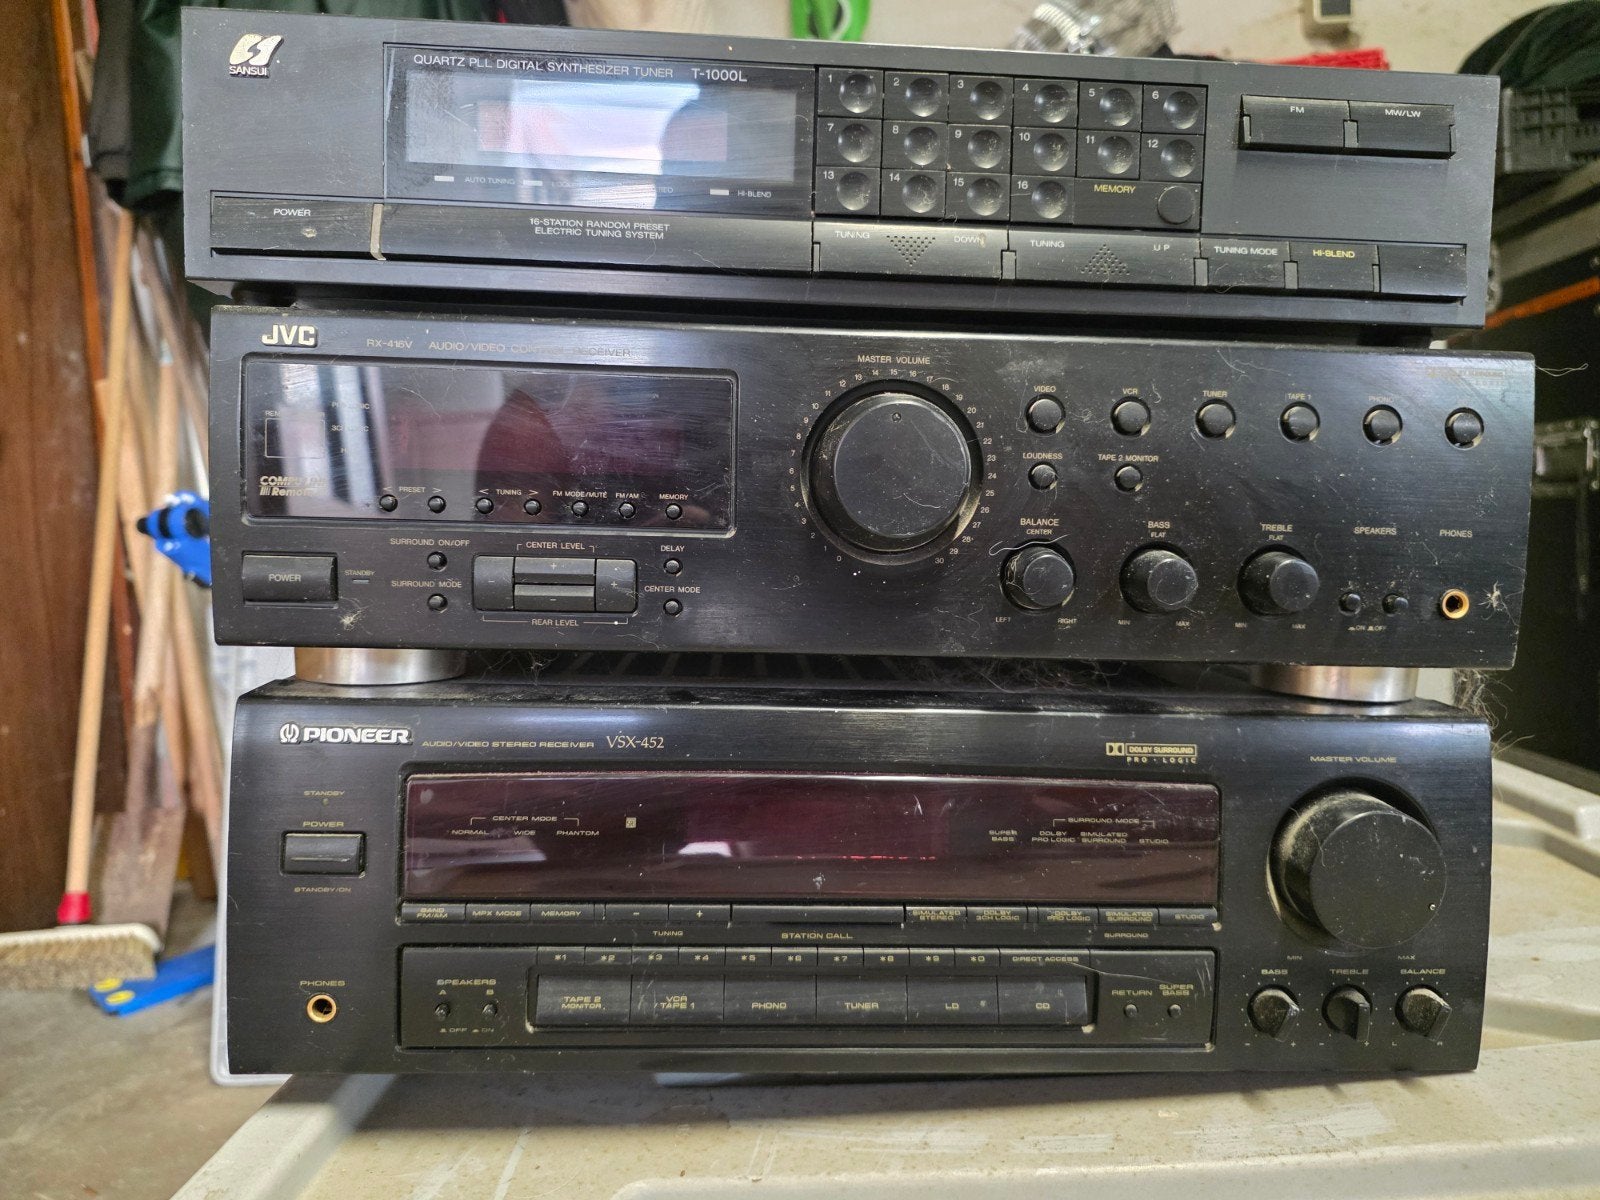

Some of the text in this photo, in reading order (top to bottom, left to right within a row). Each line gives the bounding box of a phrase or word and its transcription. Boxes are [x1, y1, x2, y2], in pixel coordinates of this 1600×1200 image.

[229, 65, 268, 77] SANSUI
[413, 54, 748, 82] QUARTZ PLL DIGITAL SYNTHESIZER TUNER T-1000L
[828, 74, 833, 82] 1
[894, 77, 900, 86] 2
[958, 80, 964, 88] 3
[1022, 83, 1029, 92] 4
[1088, 88, 1095, 98] 5
[1152, 90, 1159, 100] 6
[1290, 106, 1305, 114] FM
[1385, 109, 1421, 118] MW/LW
[827, 123, 834, 132] 7
[954, 129, 962, 138] 9
[1019, 132, 1030, 141] 10
[1085, 135, 1095, 144] 11
[1147, 139, 1159, 149] 12
[822, 170, 834, 180] 13
[889, 172, 901, 182] 14
[464, 176, 516, 185] AUTO TUNING
[953, 177, 965, 187] 15
[1017, 180, 1028, 190] 16
[1093, 184, 1137, 194] MEMORY
[738, 190, 772, 198] HI-BLEND
[273, 207, 311, 218] POWER
[529, 217, 670, 231] 16-STATION RANDOM PRESET
[534, 226, 664, 240] ELECTRIC TUNING SYSTEM
[834, 229, 870, 239] TUNING
[953, 234, 984, 245] DOWN
[1030, 239, 1065, 248] TUNING
[1214, 246, 1278, 256] TUNING MODE
[1312, 250, 1356, 258] HI-BLEND
[261, 323, 316, 347] JVC
[428, 341, 506, 353] AUDIO/VIDEO
[857, 354, 931, 365] MASTER VOLUME
[926, 375, 934, 383] 17
[1034, 385, 1056, 393] VIDEO
[1202, 390, 1228, 398] TUNER
[1288, 392, 1306, 400] TAPE
[811, 402, 819, 410] 10
[982, 437, 993, 445] 22
[1022, 452, 1063, 460] LOUDNESS
[1098, 452, 1159, 462] TAPE MONITOR
[987, 472, 997, 480] 24
[564, 491, 608, 499] MODE/MUTE
[985, 489, 995, 497] 25
[980, 506, 990, 514] 26
[1020, 518, 1060, 526] BALANCE
[1147, 520, 1171, 530] BASS
[1261, 523, 1293, 533] TREBLE
[1353, 526, 1397, 536] SPEAKERS
[1439, 528, 1473, 538] PHONES
[390, 537, 470, 547] SURROUND ON/OFF
[961, 535, 972, 543] 28
[526, 541, 586, 551] CENTER LEVEL
[660, 544, 686, 552] DELAY
[949, 547, 959, 555] 29
[268, 573, 302, 583] POWER
[391, 580, 463, 588] SURROUND MODE
[644, 585, 701, 594] CENTER MODE
[531, 618, 580, 627] REAR LEVEL
[302, 726, 411, 744] PIONEER
[606, 735, 665, 749] VSX-452
[1153, 746, 1194, 754] SURROUND
[1310, 755, 1397, 764] MASTER VOLUME
